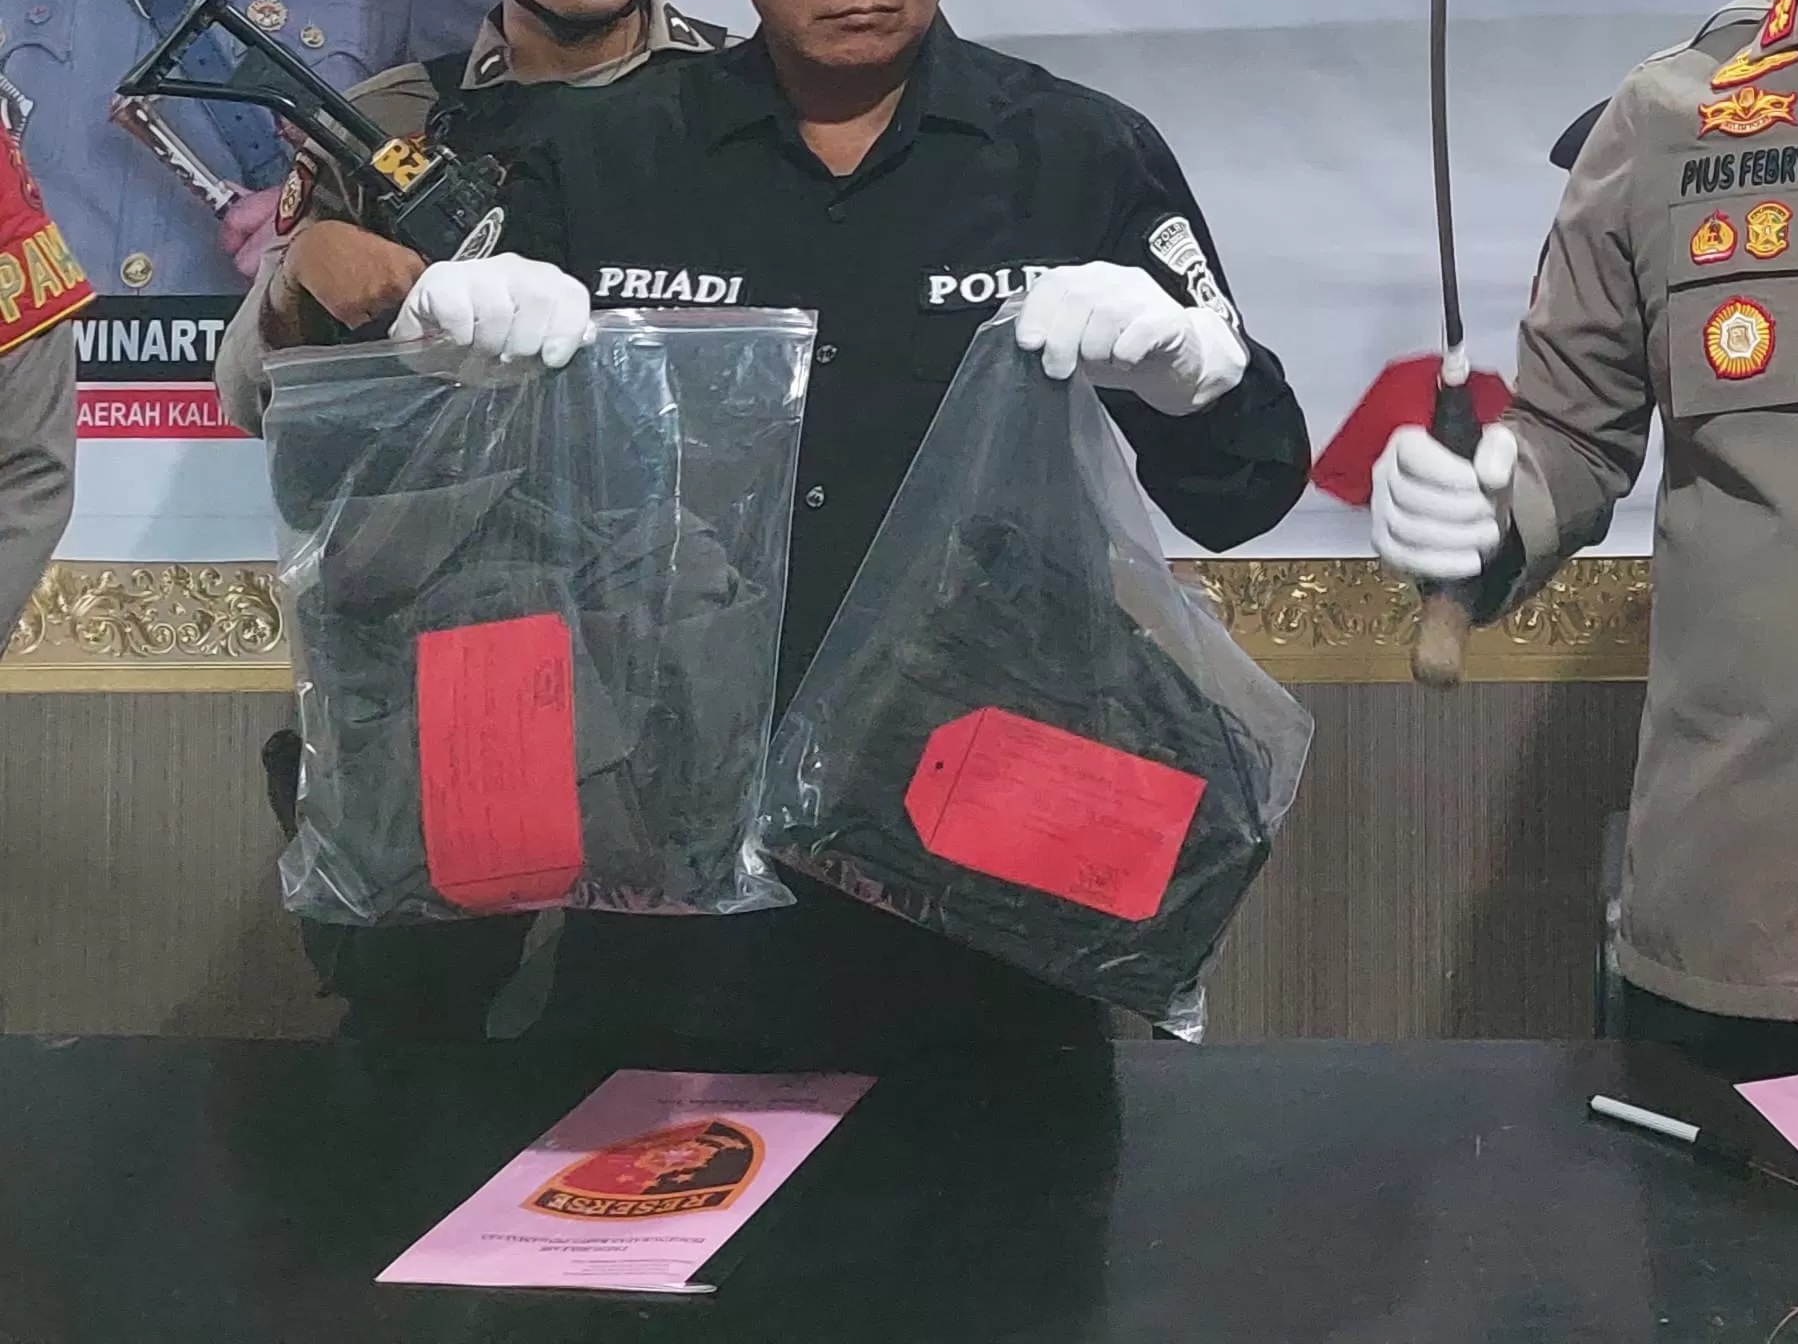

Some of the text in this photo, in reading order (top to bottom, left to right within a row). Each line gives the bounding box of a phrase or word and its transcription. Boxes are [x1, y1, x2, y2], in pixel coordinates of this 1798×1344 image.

[1681, 154, 1735, 197] PIUS
[595, 267, 743, 303] PRIADI
[72, 319, 224, 362] WINART
[77, 403, 232, 427] AERAH KALI
[549, 1192, 711, 1215] RESERSE
